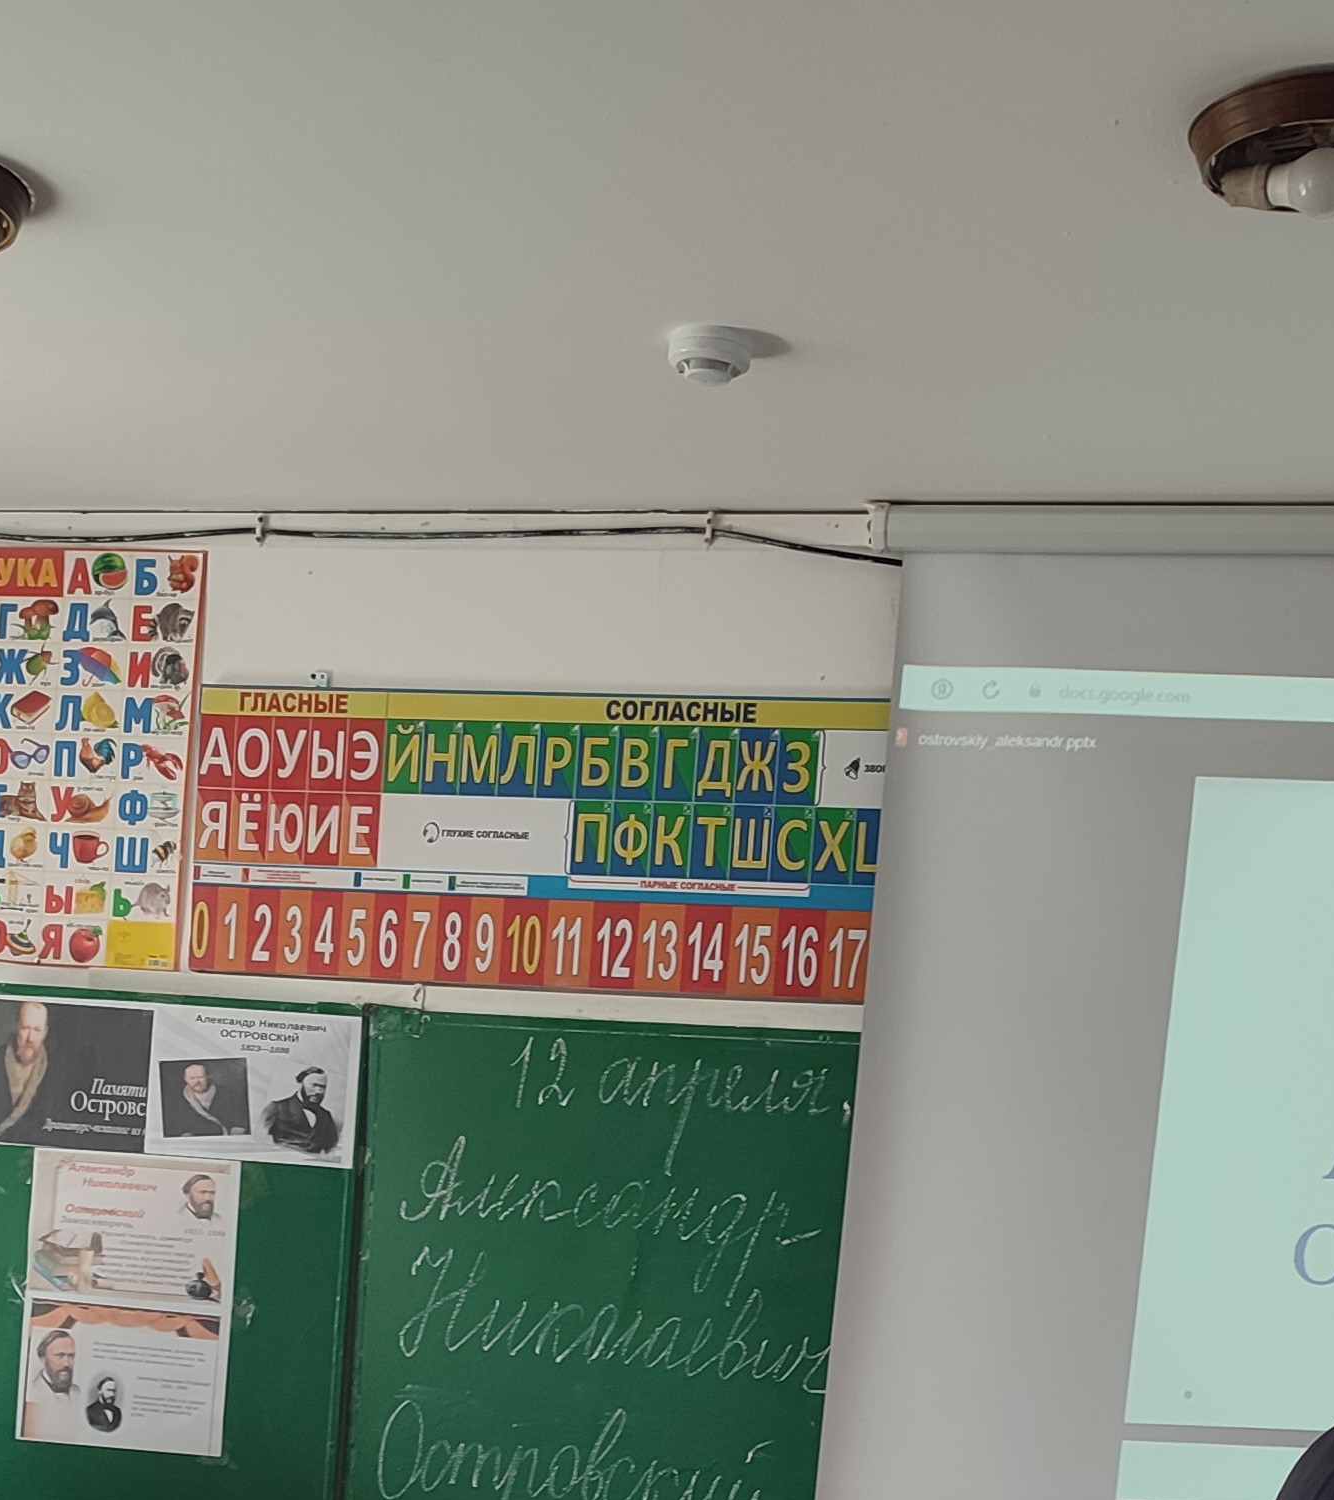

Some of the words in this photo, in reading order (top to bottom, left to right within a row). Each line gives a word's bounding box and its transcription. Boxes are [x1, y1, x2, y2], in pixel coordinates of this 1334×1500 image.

[67, 557, 92, 595] А
[134, 558, 158, 596] Б
[62, 603, 90, 642] Д
[127, 651, 151, 688] И
[55, 695, 82, 731] Л
[123, 697, 153, 733] М
[239, 691, 349, 714] ГЛАСНЫЕ
[605, 700, 758, 723] СОГЛАСНЫЕ
[53, 740, 77, 778] П
[121, 742, 144, 780] Р
[51, 786, 75, 822] У
[118, 789, 149, 826] Ф
[49, 831, 70, 869] Ч
[114, 836, 149, 874] Ш
[45, 884, 73, 915] Ы
[112, 888, 132, 918] Ь
[39, 923, 64, 960] Я
[192, 901, 209, 959] 0
[224, 903, 238, 960] 1
[251, 904, 272, 962] 2
[283, 905, 303, 964] 3
[314, 906, 334, 965] 4
[347, 908, 367, 967] 5
[378, 909, 398, 968] 6
[412, 911, 431, 969] 7
[442, 911, 462, 971] 8
[474, 913, 495, 973] 9
[507, 914, 542, 976] 10
[551, 916, 583, 977] 11
[596, 918, 633, 979] 12
[642, 919, 678, 981] 13
[687, 921, 725, 982] 14
[734, 923, 772, 985] 15
[781, 925, 819, 988] 16
[828, 927, 868, 989] 17
[195, 1014, 256, 1030] Александр
[220, 1028, 300, 1043] ОСТРОВСКИЙ
[90, 1077, 147, 1098] Памяти
[510, 1036, 576, 1109] 12
